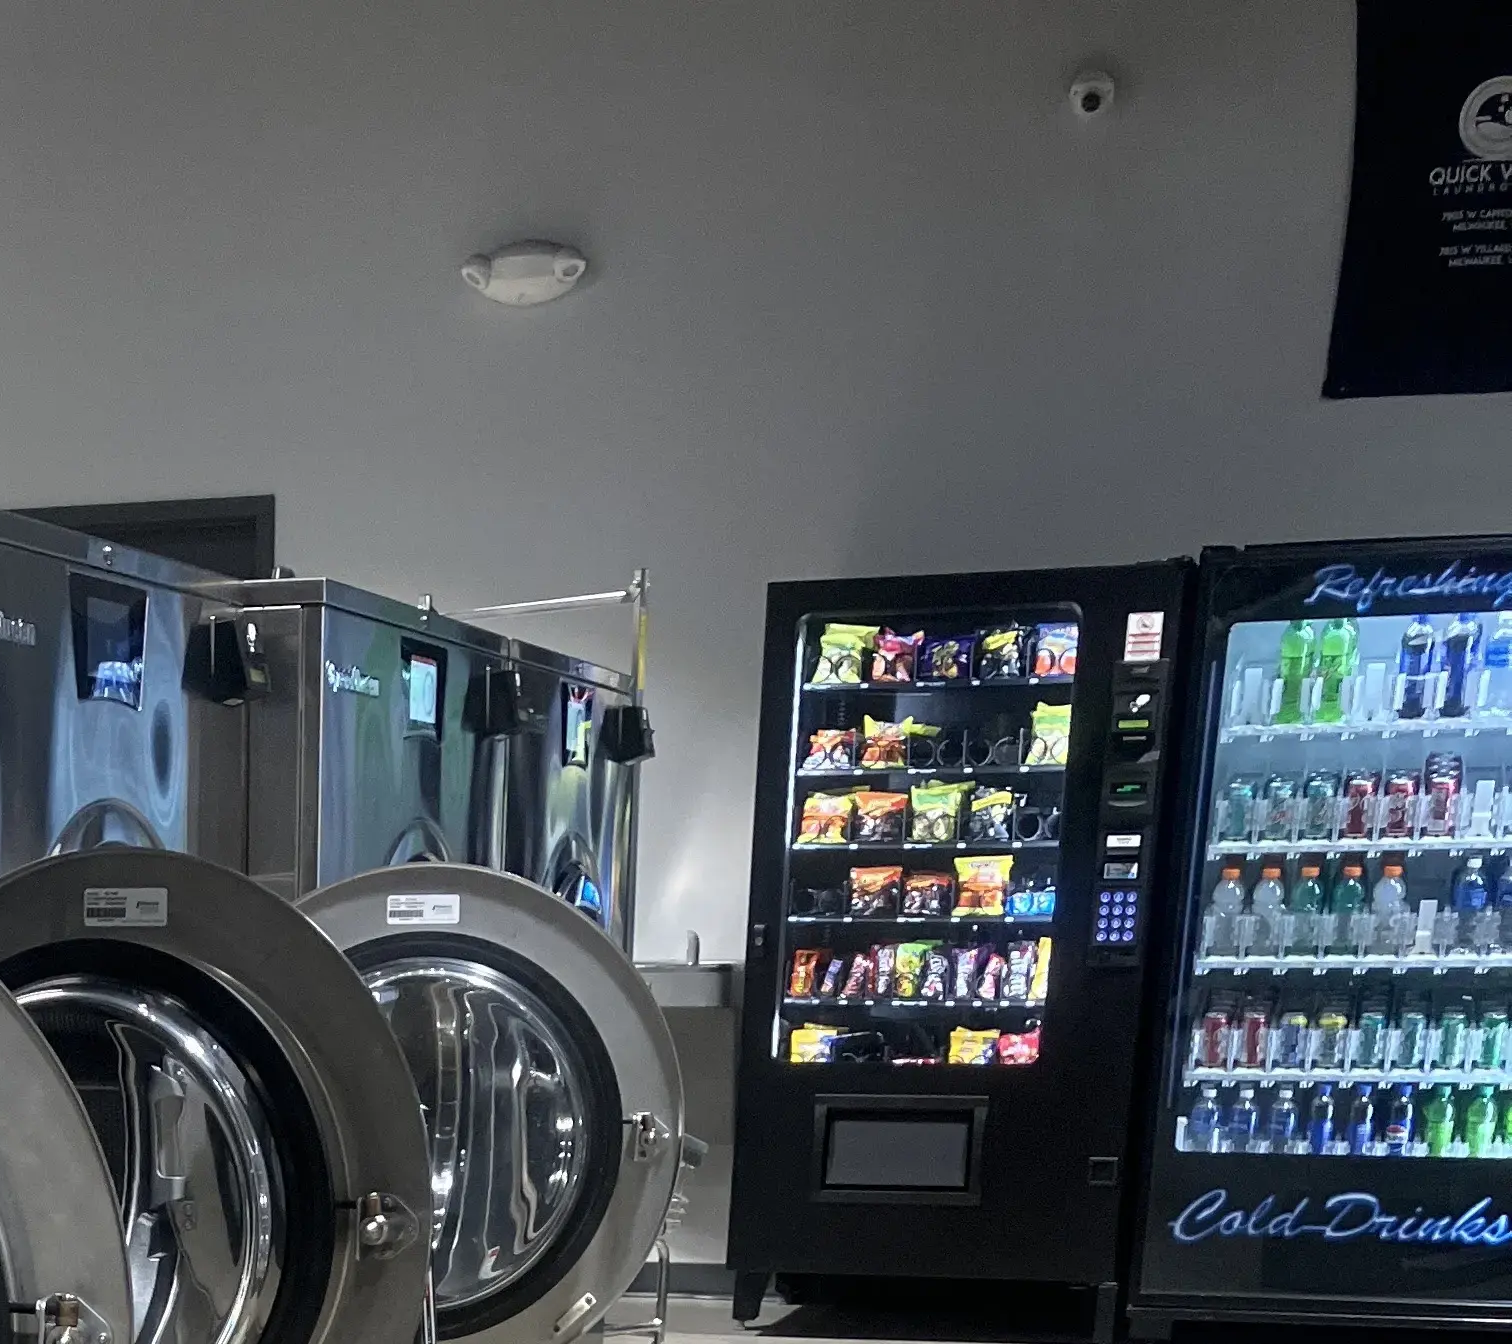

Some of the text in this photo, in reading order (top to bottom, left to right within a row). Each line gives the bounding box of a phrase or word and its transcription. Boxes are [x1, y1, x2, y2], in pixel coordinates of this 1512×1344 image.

[1429, 164, 1492, 185] QUICK
[1304, 559, 1512, 613] Refreshing
[1168, 1188, 1512, 1246] Cold Drinks
